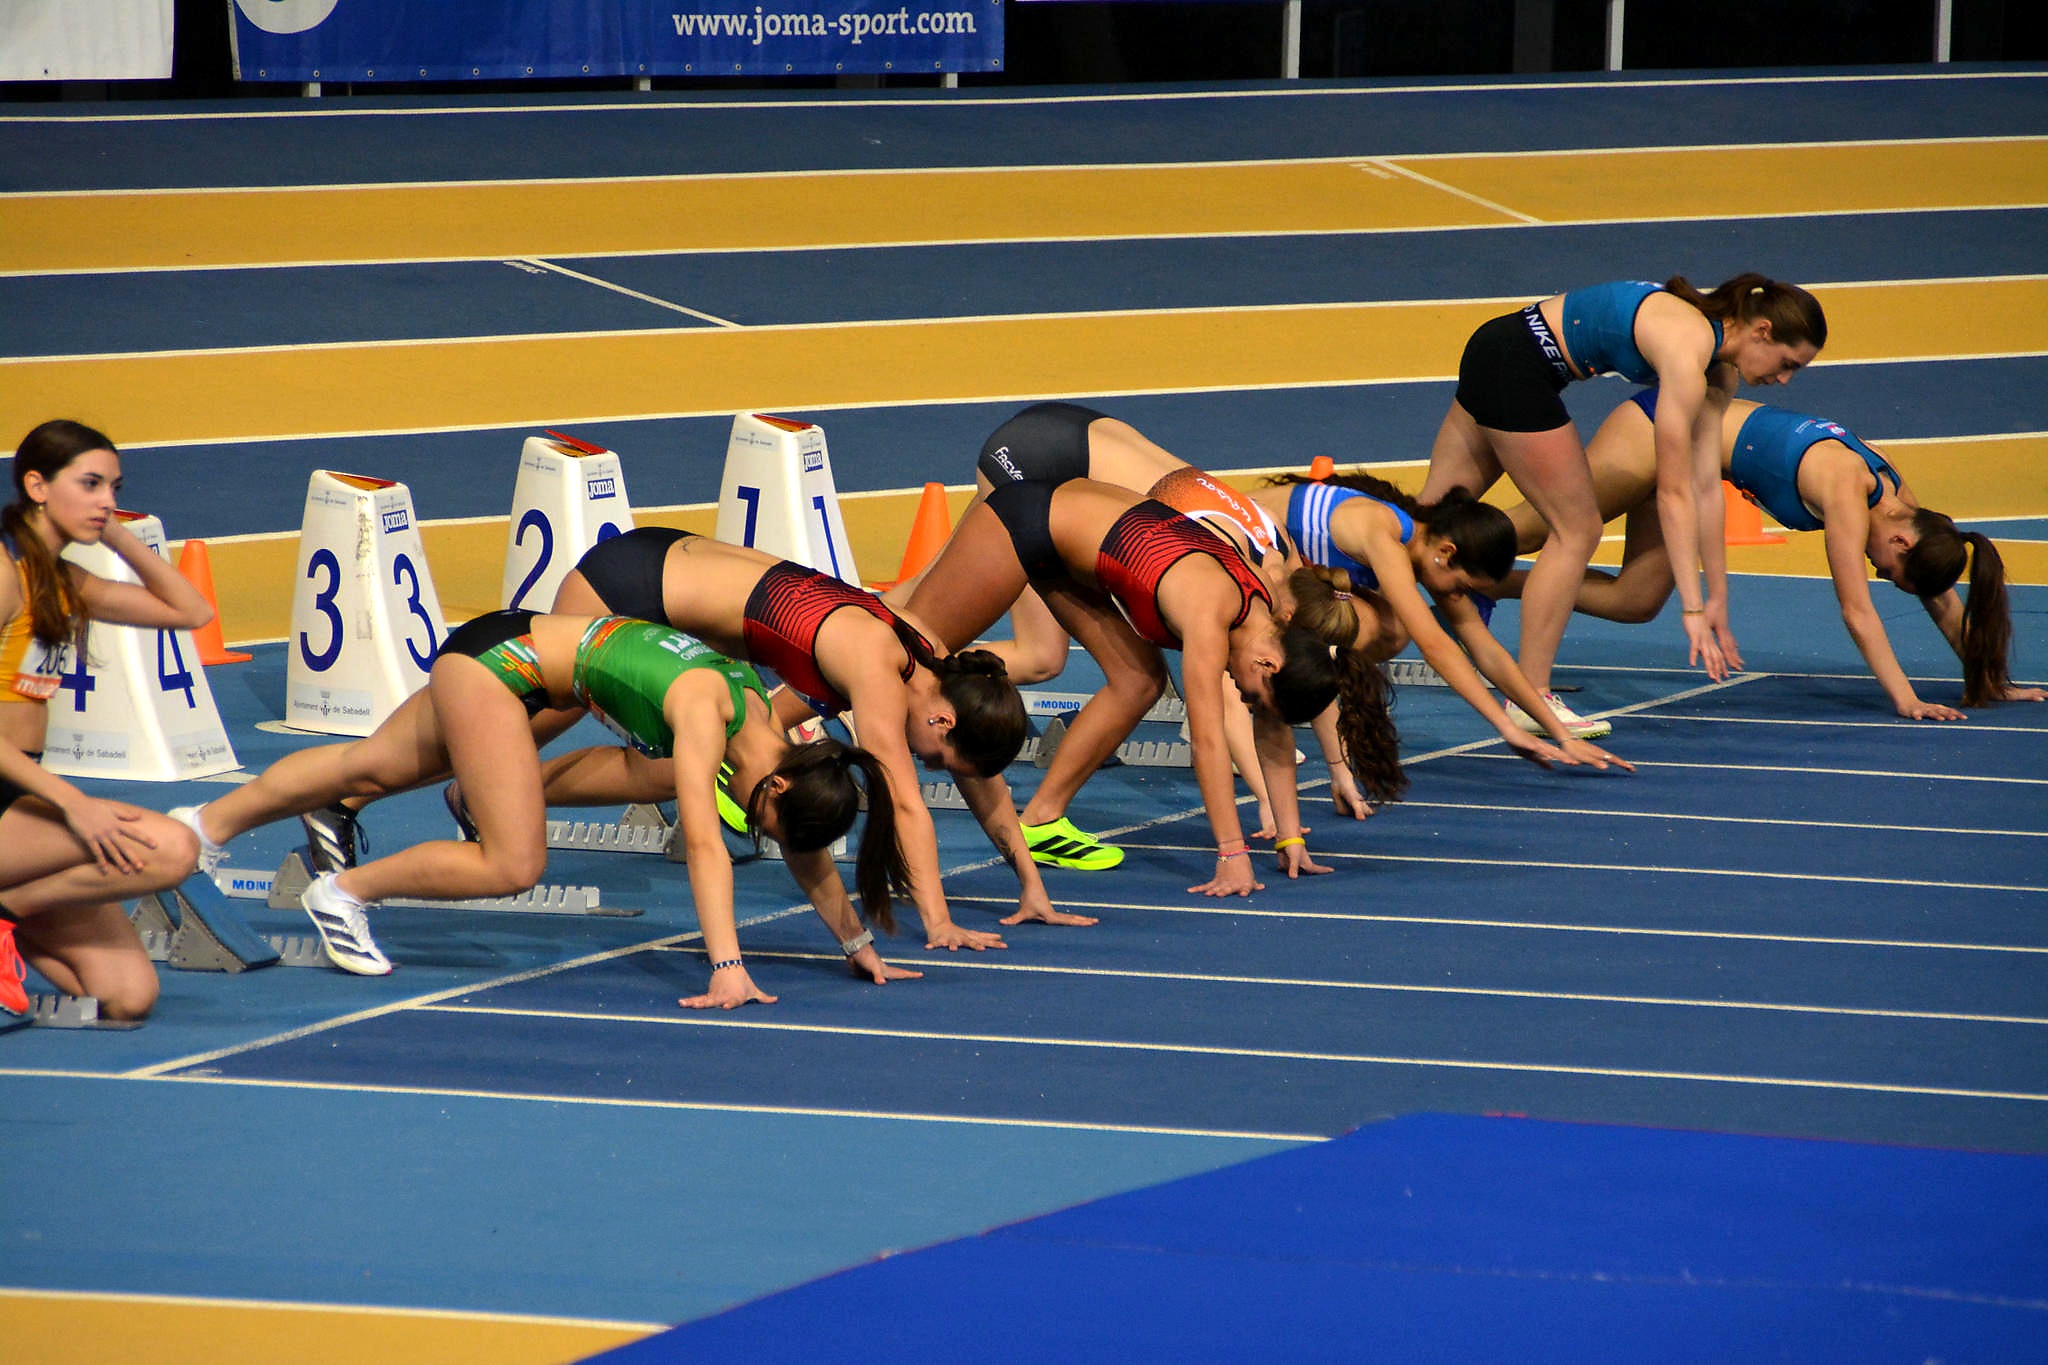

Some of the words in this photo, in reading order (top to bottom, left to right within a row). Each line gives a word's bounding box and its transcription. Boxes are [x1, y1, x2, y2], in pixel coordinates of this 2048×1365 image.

[672, 6, 977, 45] www.joma-sport.com
[1525, 313, 1562, 359] NIKE
[737, 485, 760, 549] 1
[812, 495, 840, 580] 1
[509, 509, 554, 611] 2
[300, 548, 344, 672] 3
[393, 553, 438, 674] 3
[157, 628, 196, 709] 4
[1040, 700, 1081, 710] MONDO
